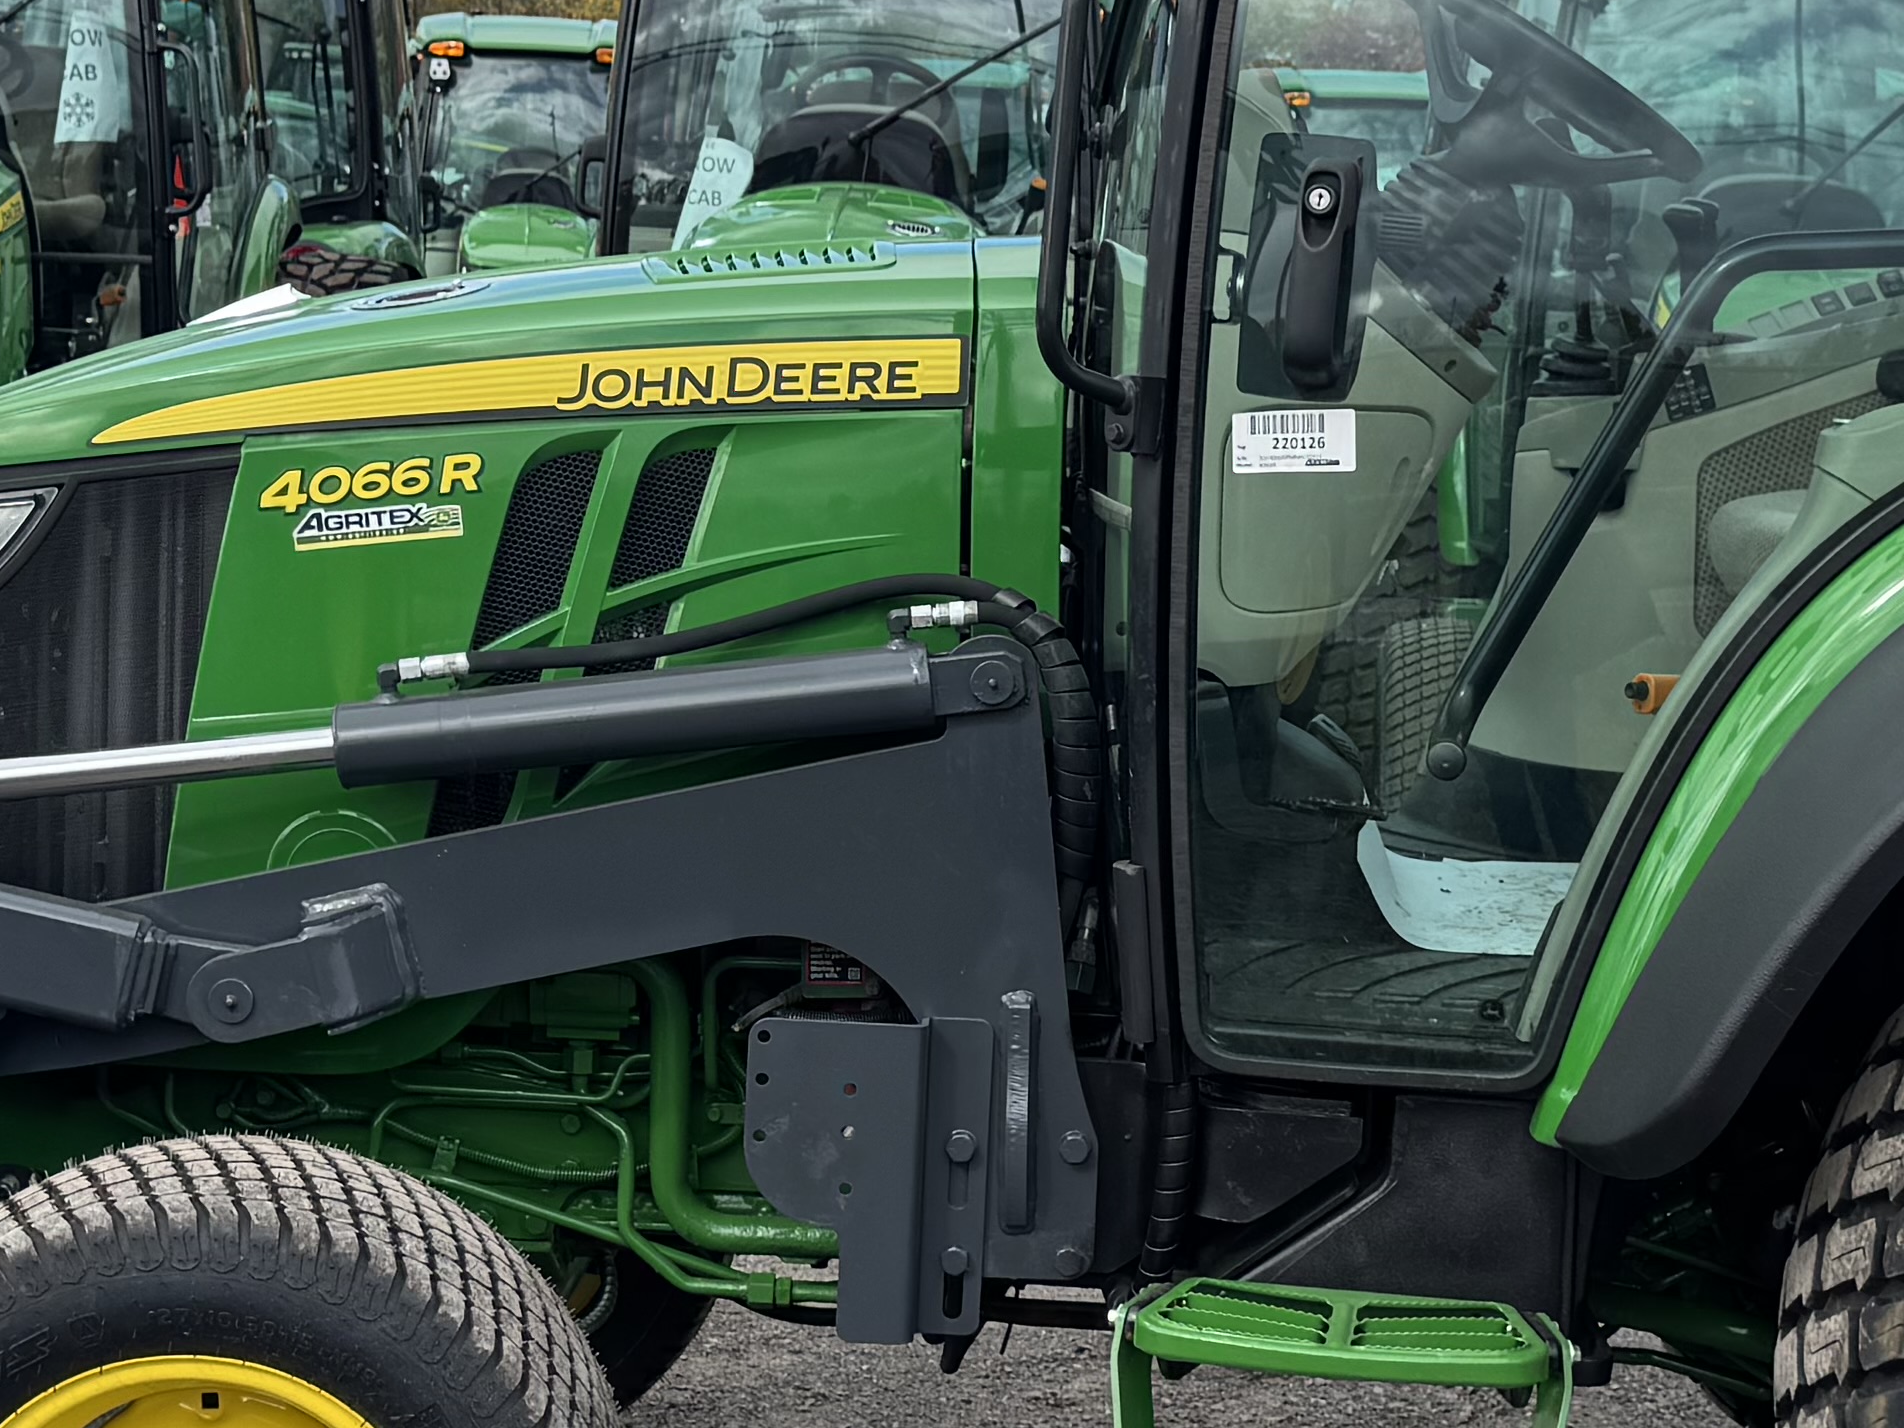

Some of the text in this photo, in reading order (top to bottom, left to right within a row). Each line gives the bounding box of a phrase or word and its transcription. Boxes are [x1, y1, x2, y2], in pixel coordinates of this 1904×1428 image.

[66, 63, 98, 81] AB
[557, 357, 919, 404] JOHN DEERE
[1272, 436, 1326, 450] 220126
[297, 506, 425, 535] AGRITEX
